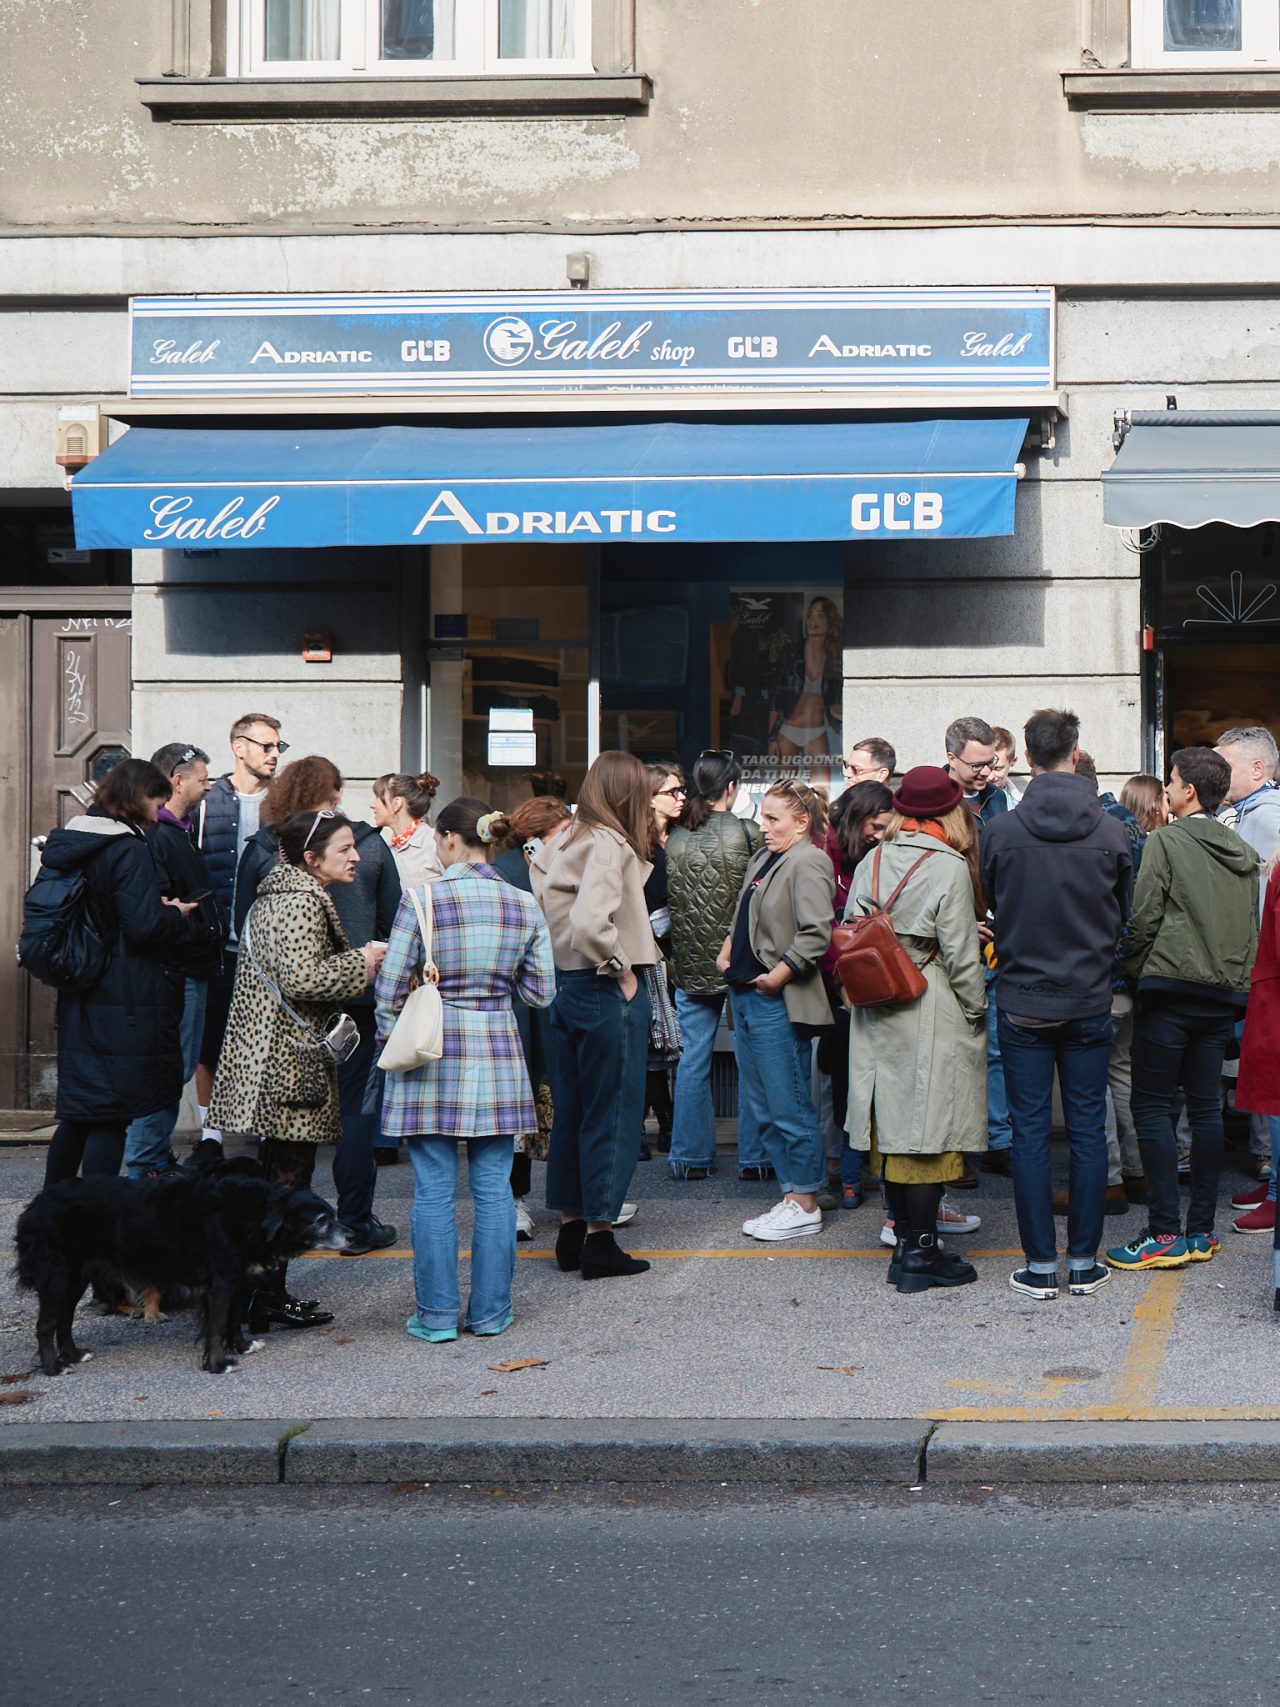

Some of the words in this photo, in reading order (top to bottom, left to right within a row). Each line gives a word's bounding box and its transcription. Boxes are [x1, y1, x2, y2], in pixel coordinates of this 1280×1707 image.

[149, 339, 220, 365] Galeb
[249, 340, 373, 364] ADRIATIC
[534, 319, 653, 361] Galeb
[650, 339, 696, 367] shop
[808, 334, 932, 358] ADRIATIC
[959, 331, 1033, 358] Galeb
[143, 495, 281, 541] Galeb
[411, 490, 677, 536] ADRIATIC
[741, 755, 781, 765] TAKO
[741, 769, 762, 779] DA
[765, 769, 778, 779] TI
[779, 769, 811, 779] NIJE
